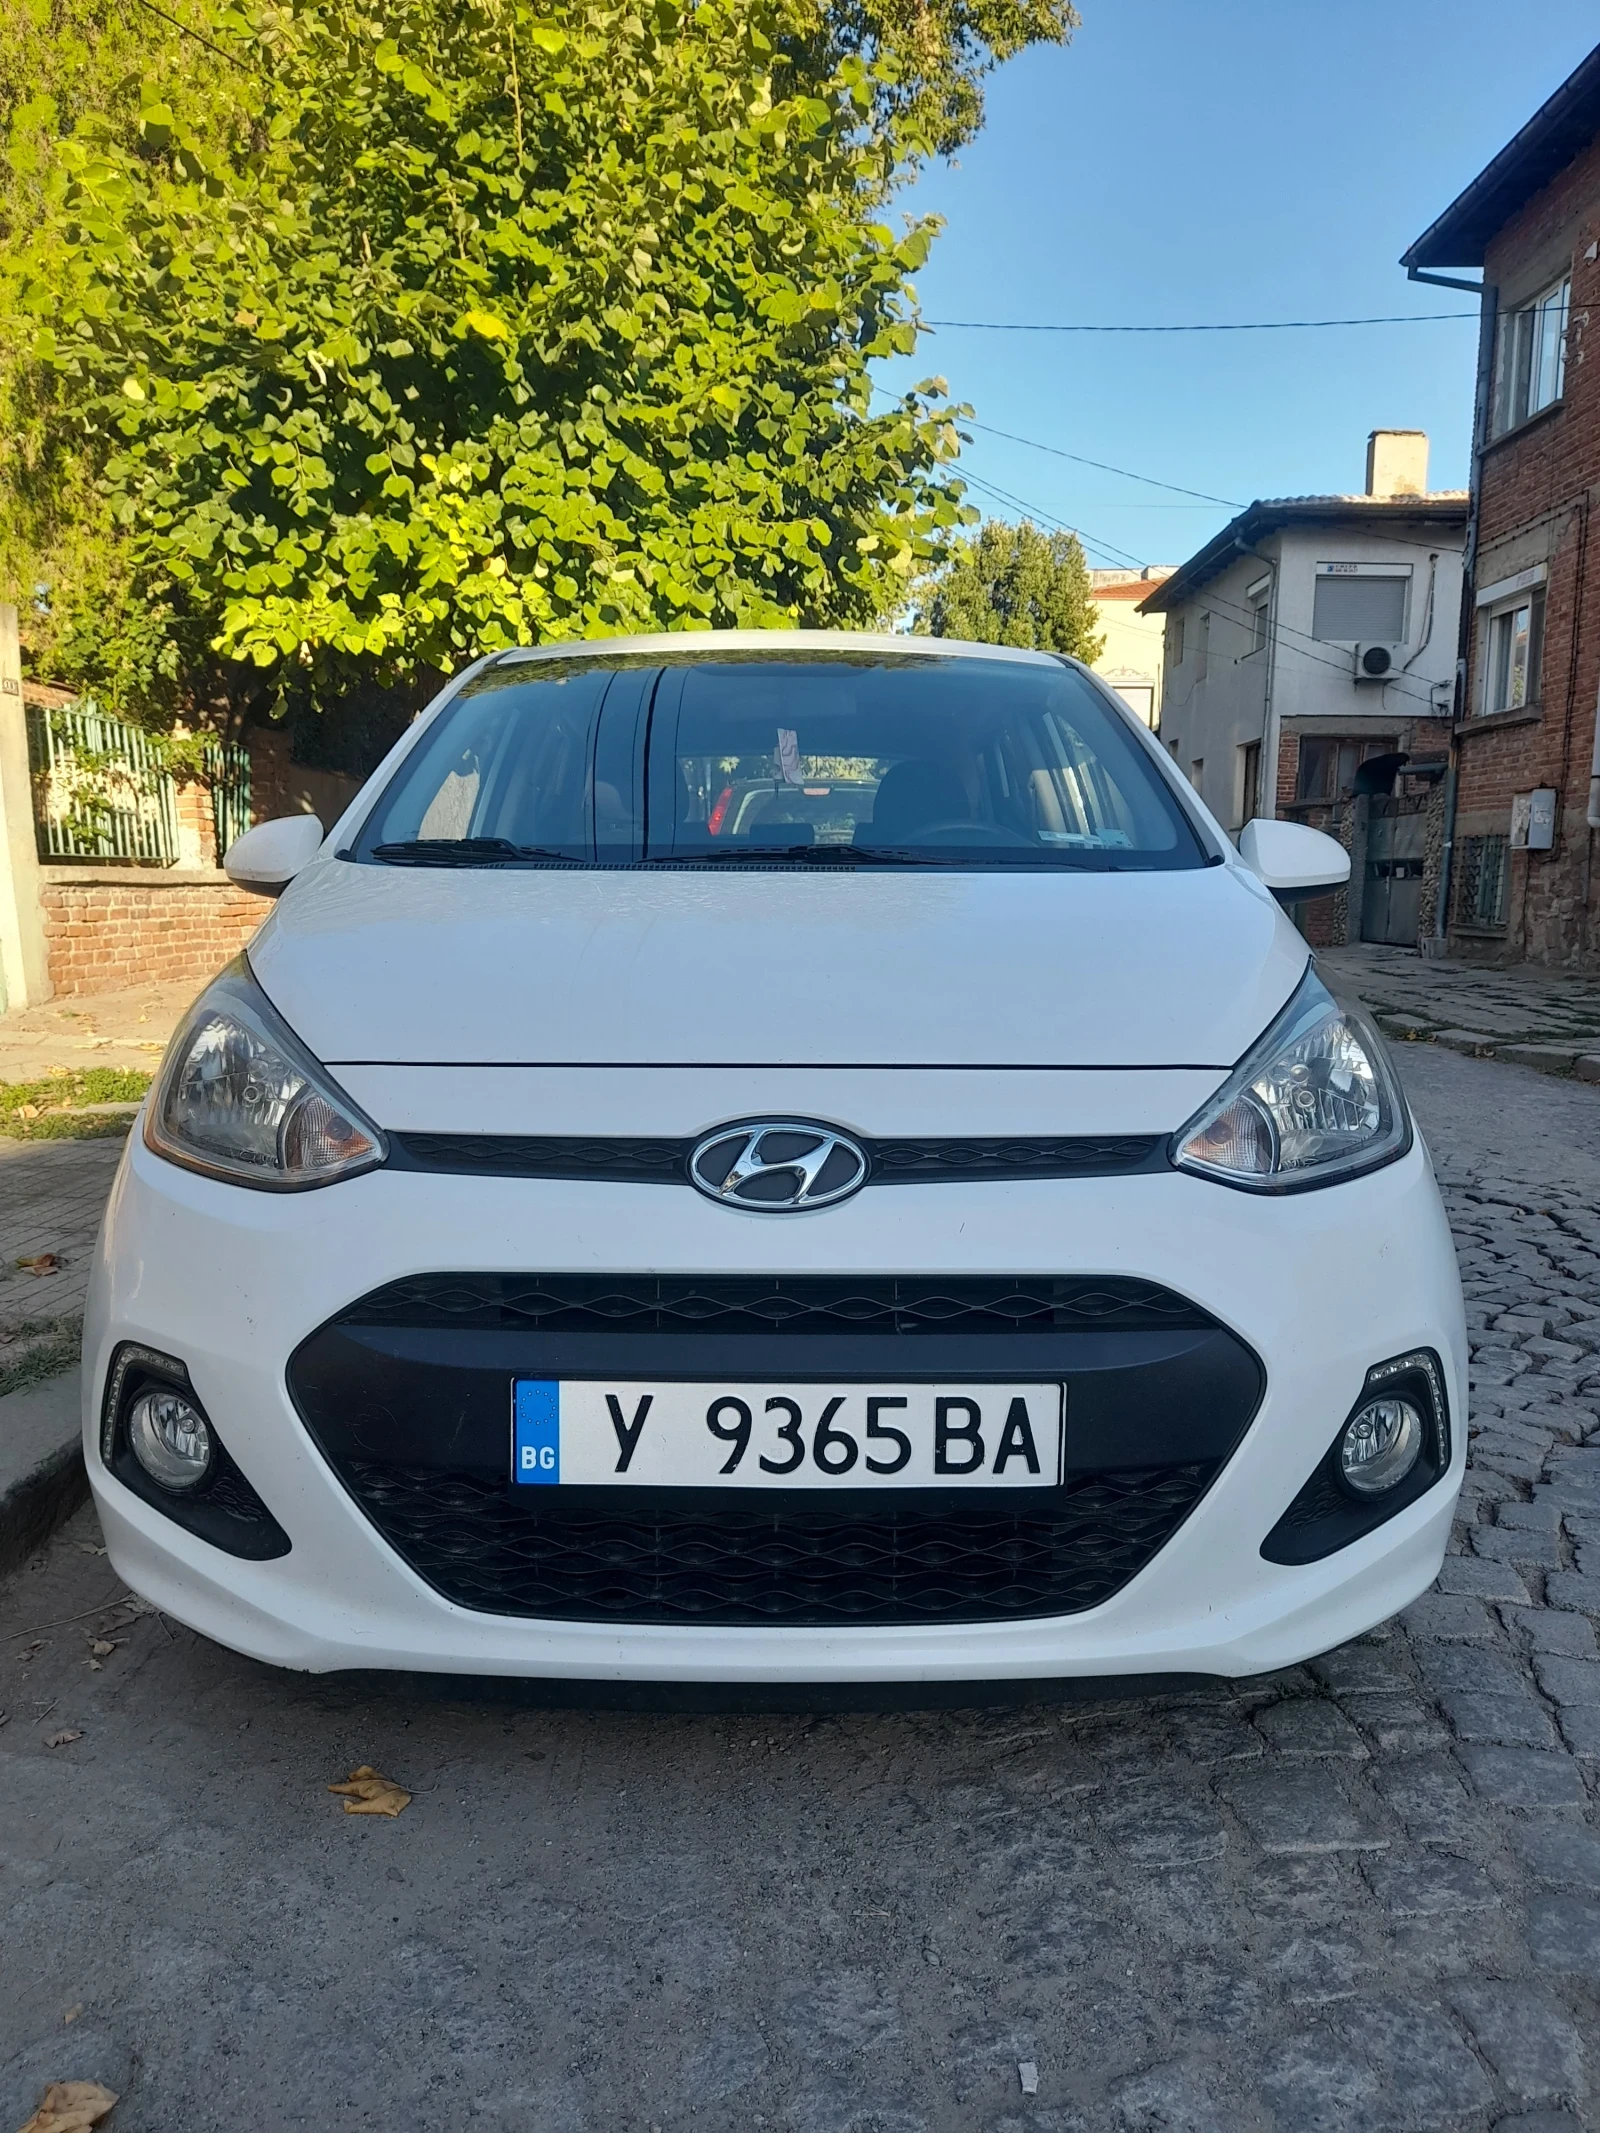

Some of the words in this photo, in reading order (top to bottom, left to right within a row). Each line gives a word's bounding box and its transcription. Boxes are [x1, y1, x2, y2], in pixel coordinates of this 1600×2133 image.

[521, 1446, 555, 1470] BG
[706, 1396, 912, 1475] 9365
[934, 1396, 1041, 1475] BA
